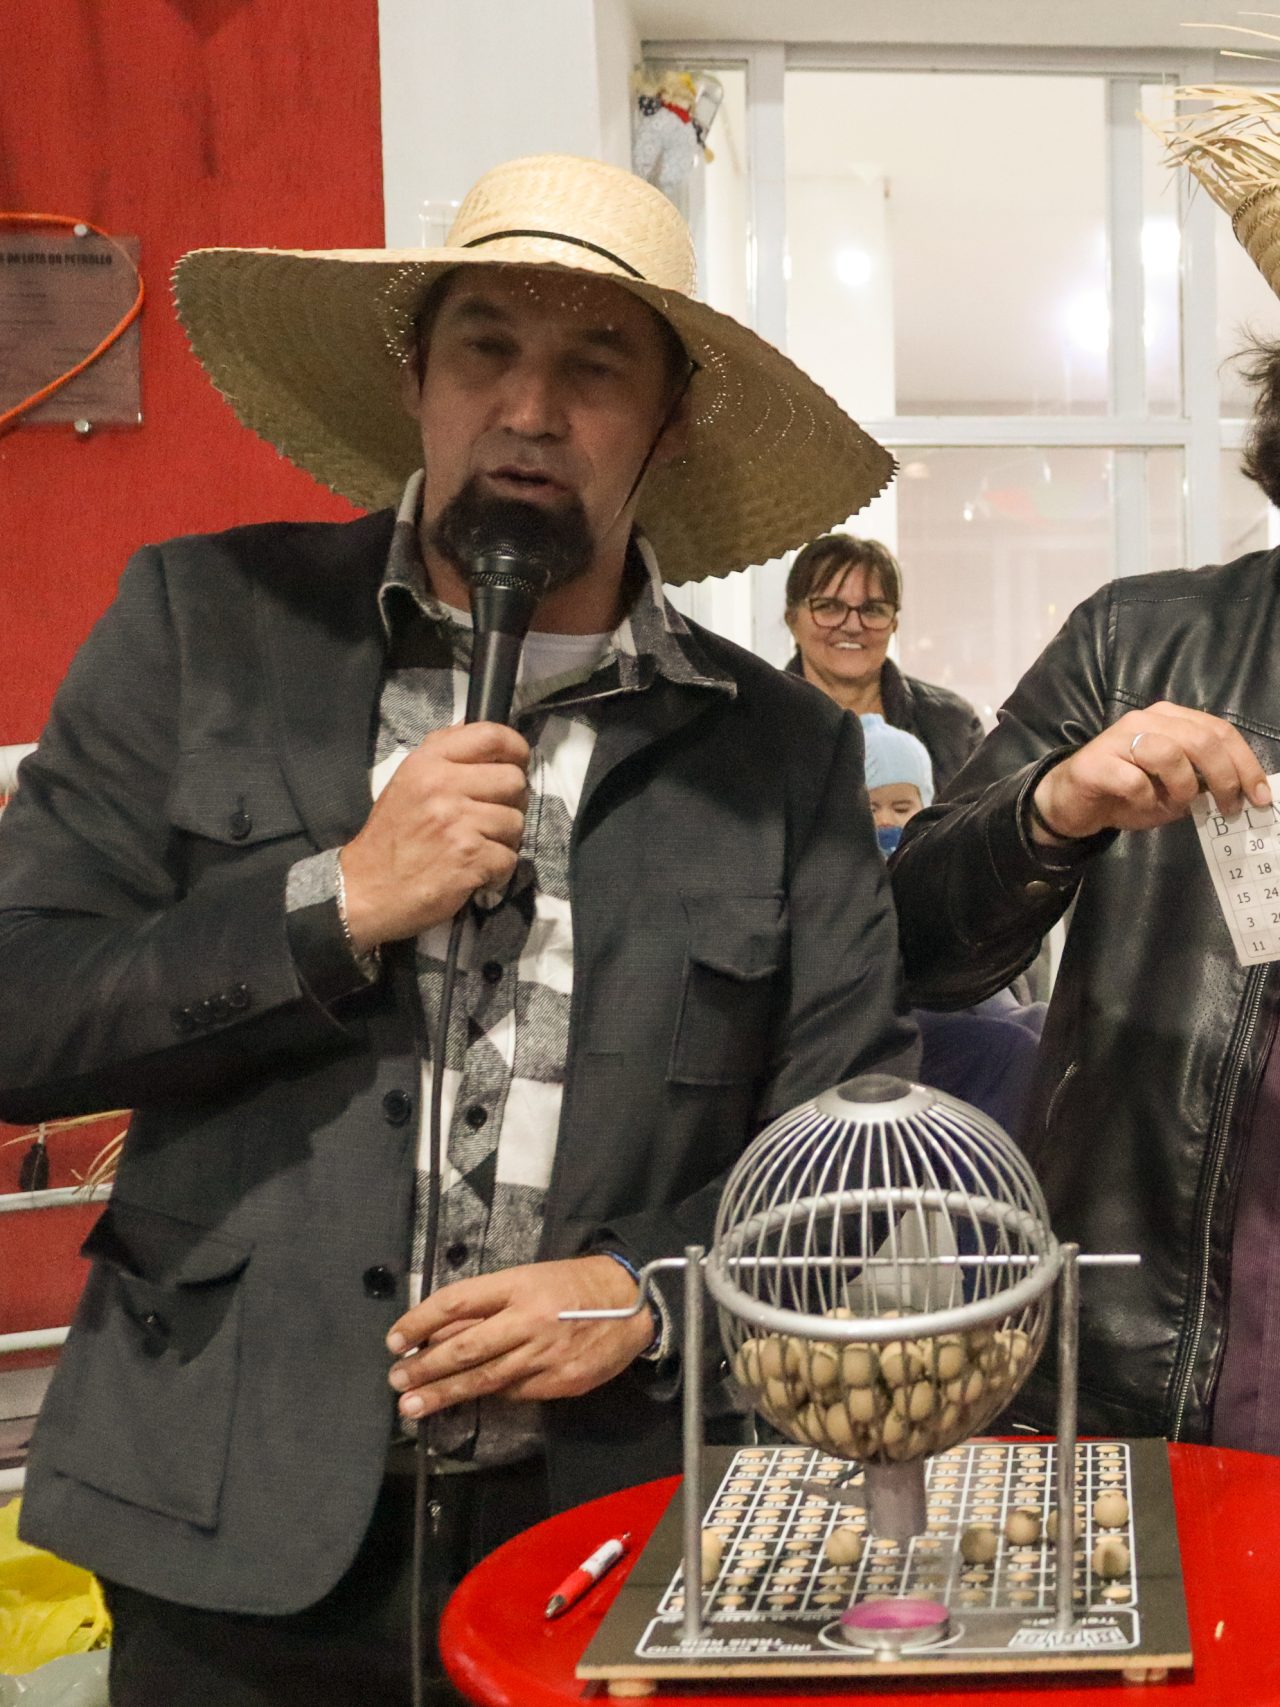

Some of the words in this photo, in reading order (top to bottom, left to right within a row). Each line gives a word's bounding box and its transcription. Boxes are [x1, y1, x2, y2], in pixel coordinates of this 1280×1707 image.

[1223, 844, 1232, 856] 9
[1249, 838, 1265, 852] 30
[1229, 868, 1244, 880] 12
[1257, 862, 1272, 875] 18
[1237, 891, 1251, 904] 15
[1264, 887, 1279, 899] 24
[1246, 917, 1255, 928] 3
[1252, 941, 1266, 952] 11
